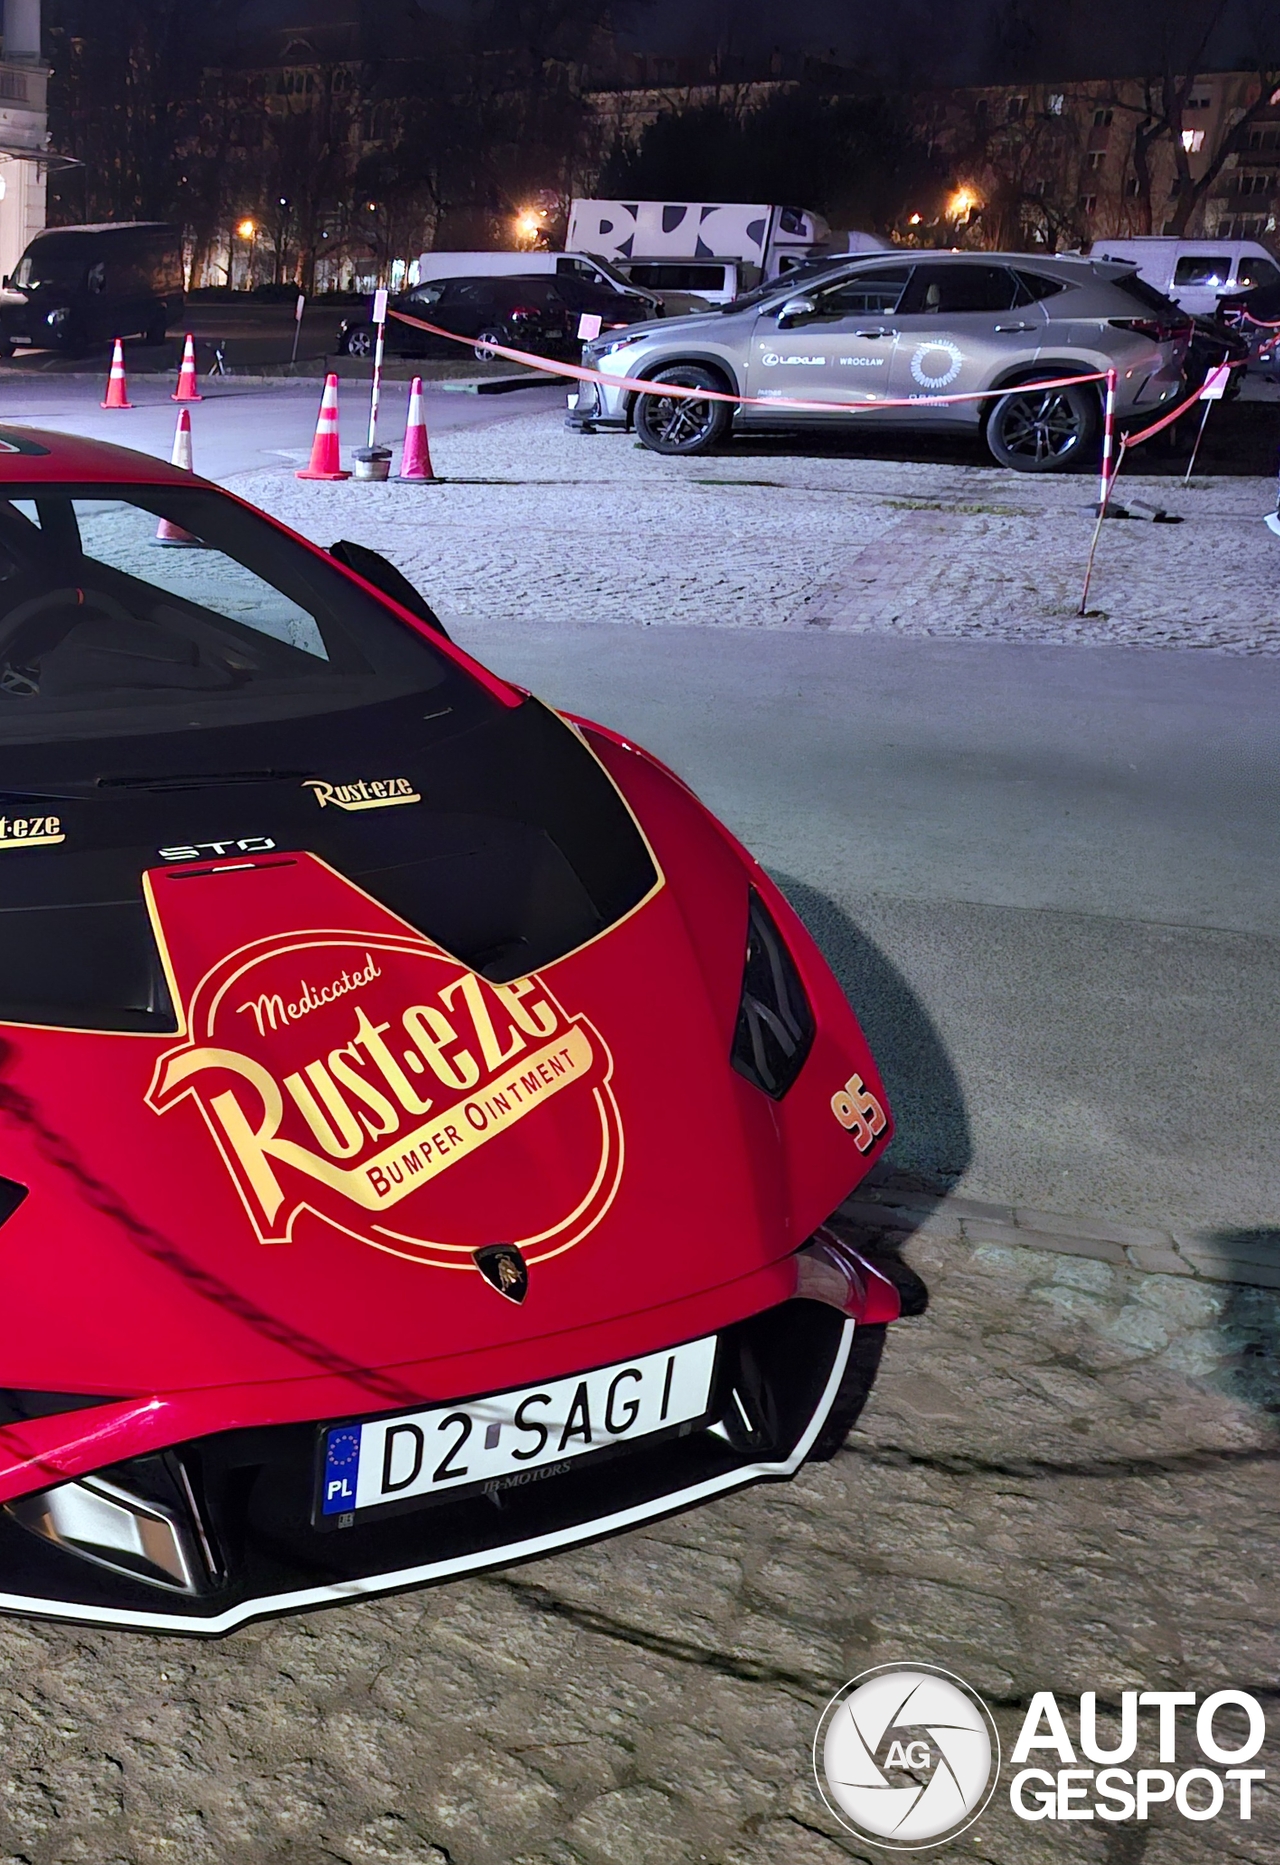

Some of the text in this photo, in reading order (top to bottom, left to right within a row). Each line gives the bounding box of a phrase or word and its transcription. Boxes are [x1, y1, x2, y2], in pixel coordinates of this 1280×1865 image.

[780, 356, 884, 366] LEXUS WROCŁAW
[158, 836, 276, 860] STO
[236, 952, 382, 1036] Medicated
[365, 1047, 577, 1198] BUMPER OINTMENT
[830, 1072, 888, 1153] 95
[380, 1354, 676, 1495] D2 SAGI
[327, 1478, 353, 1501] PL
